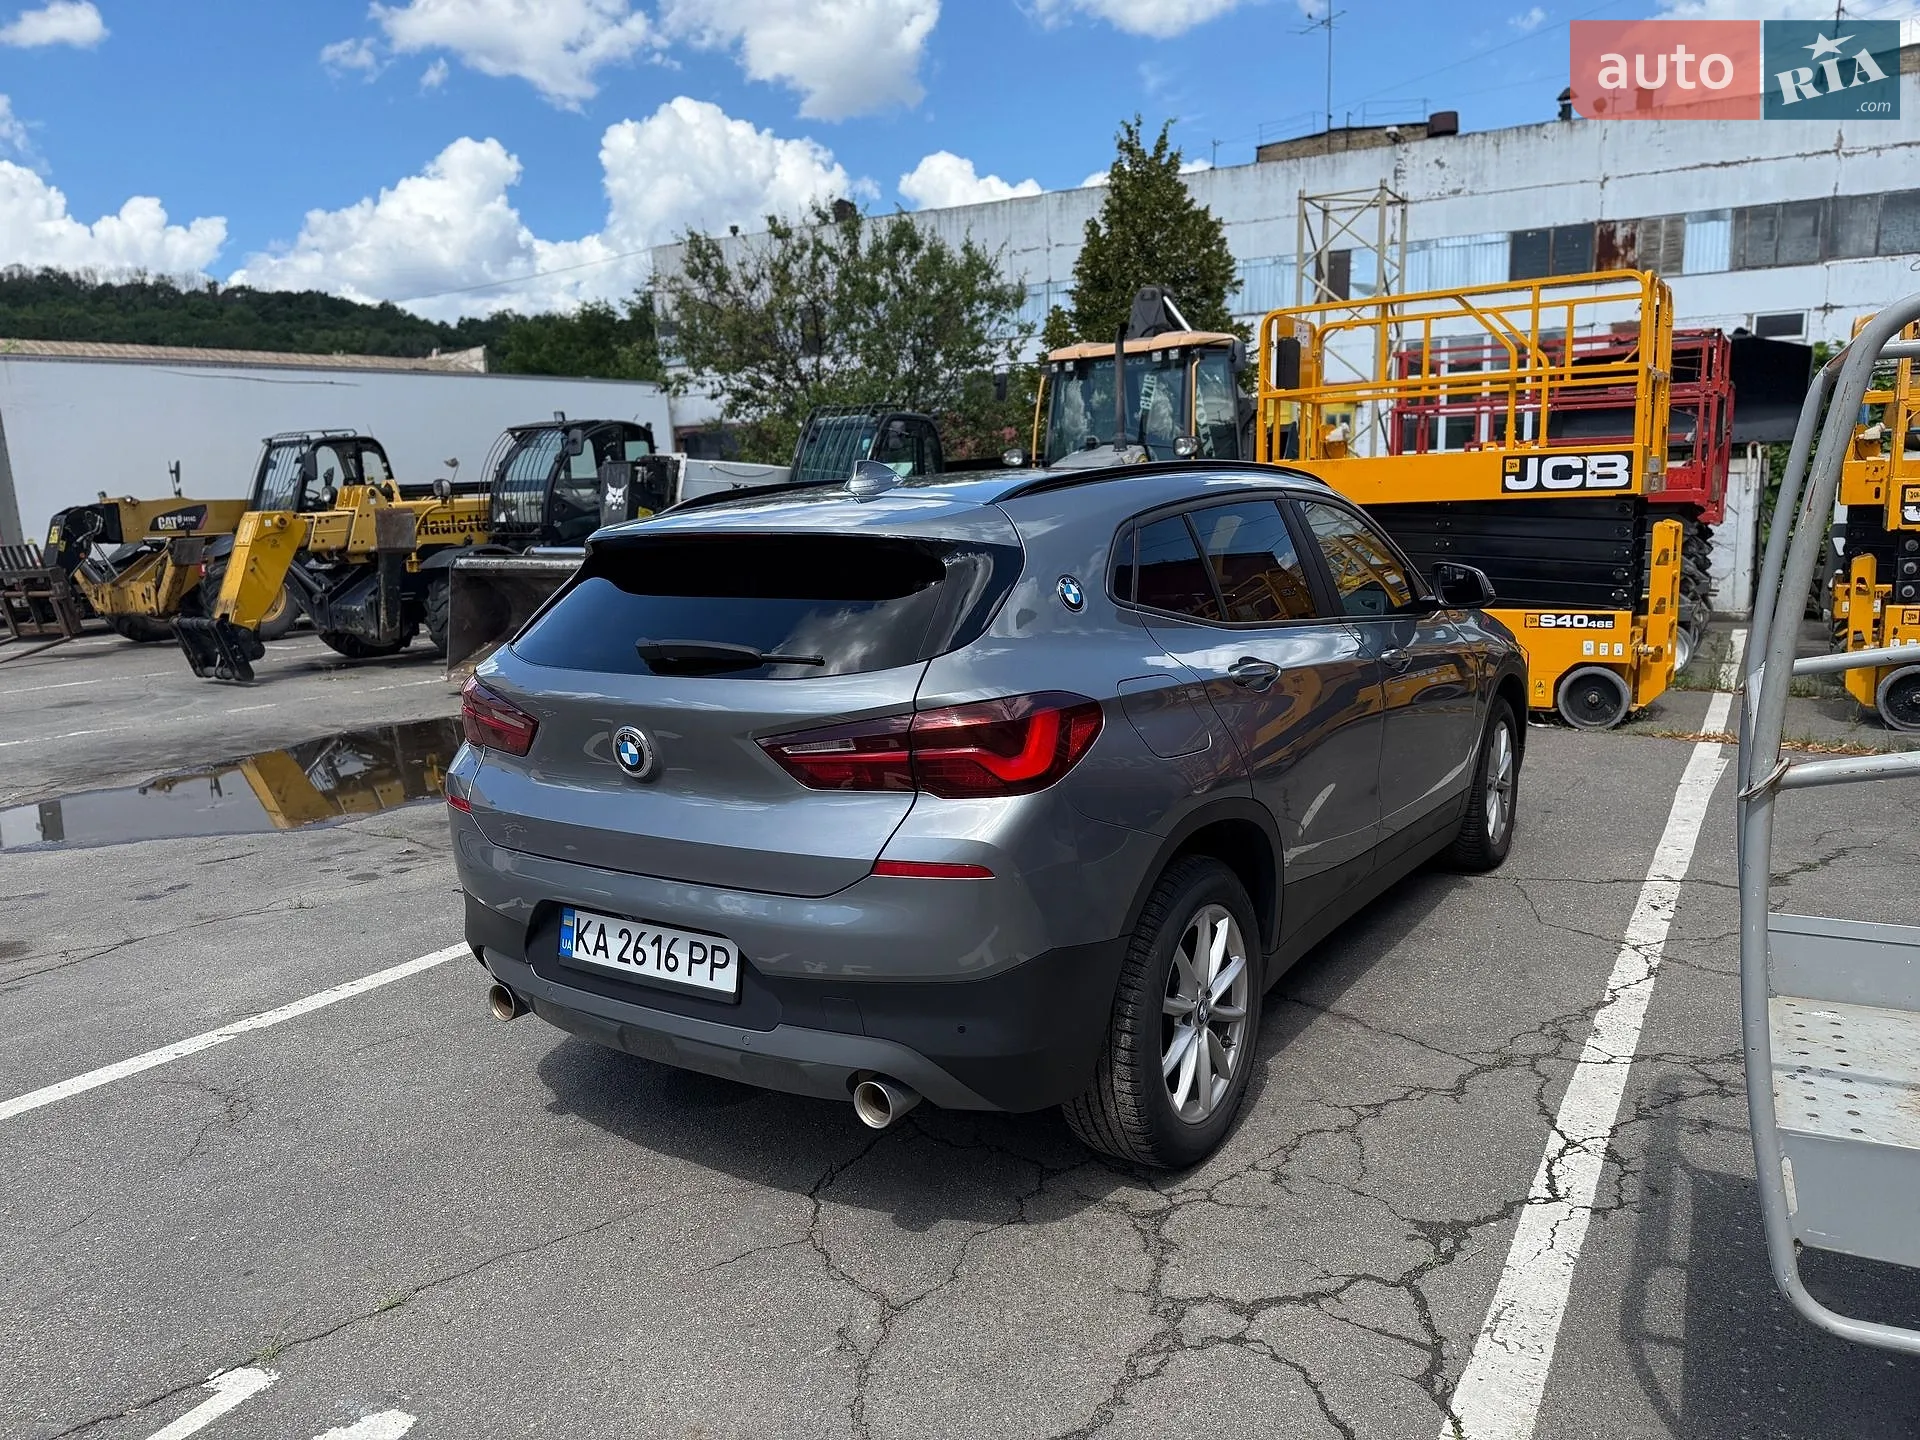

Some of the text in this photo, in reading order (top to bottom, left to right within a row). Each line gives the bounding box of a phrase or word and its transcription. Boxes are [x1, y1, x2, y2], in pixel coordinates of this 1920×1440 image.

[1095, 357, 1145, 369] VOVO
[1505, 454, 1629, 490] JCB
[158, 516, 177, 530] CAT
[562, 938, 572, 951] UA
[575, 917, 731, 982] KA 2616 PP
